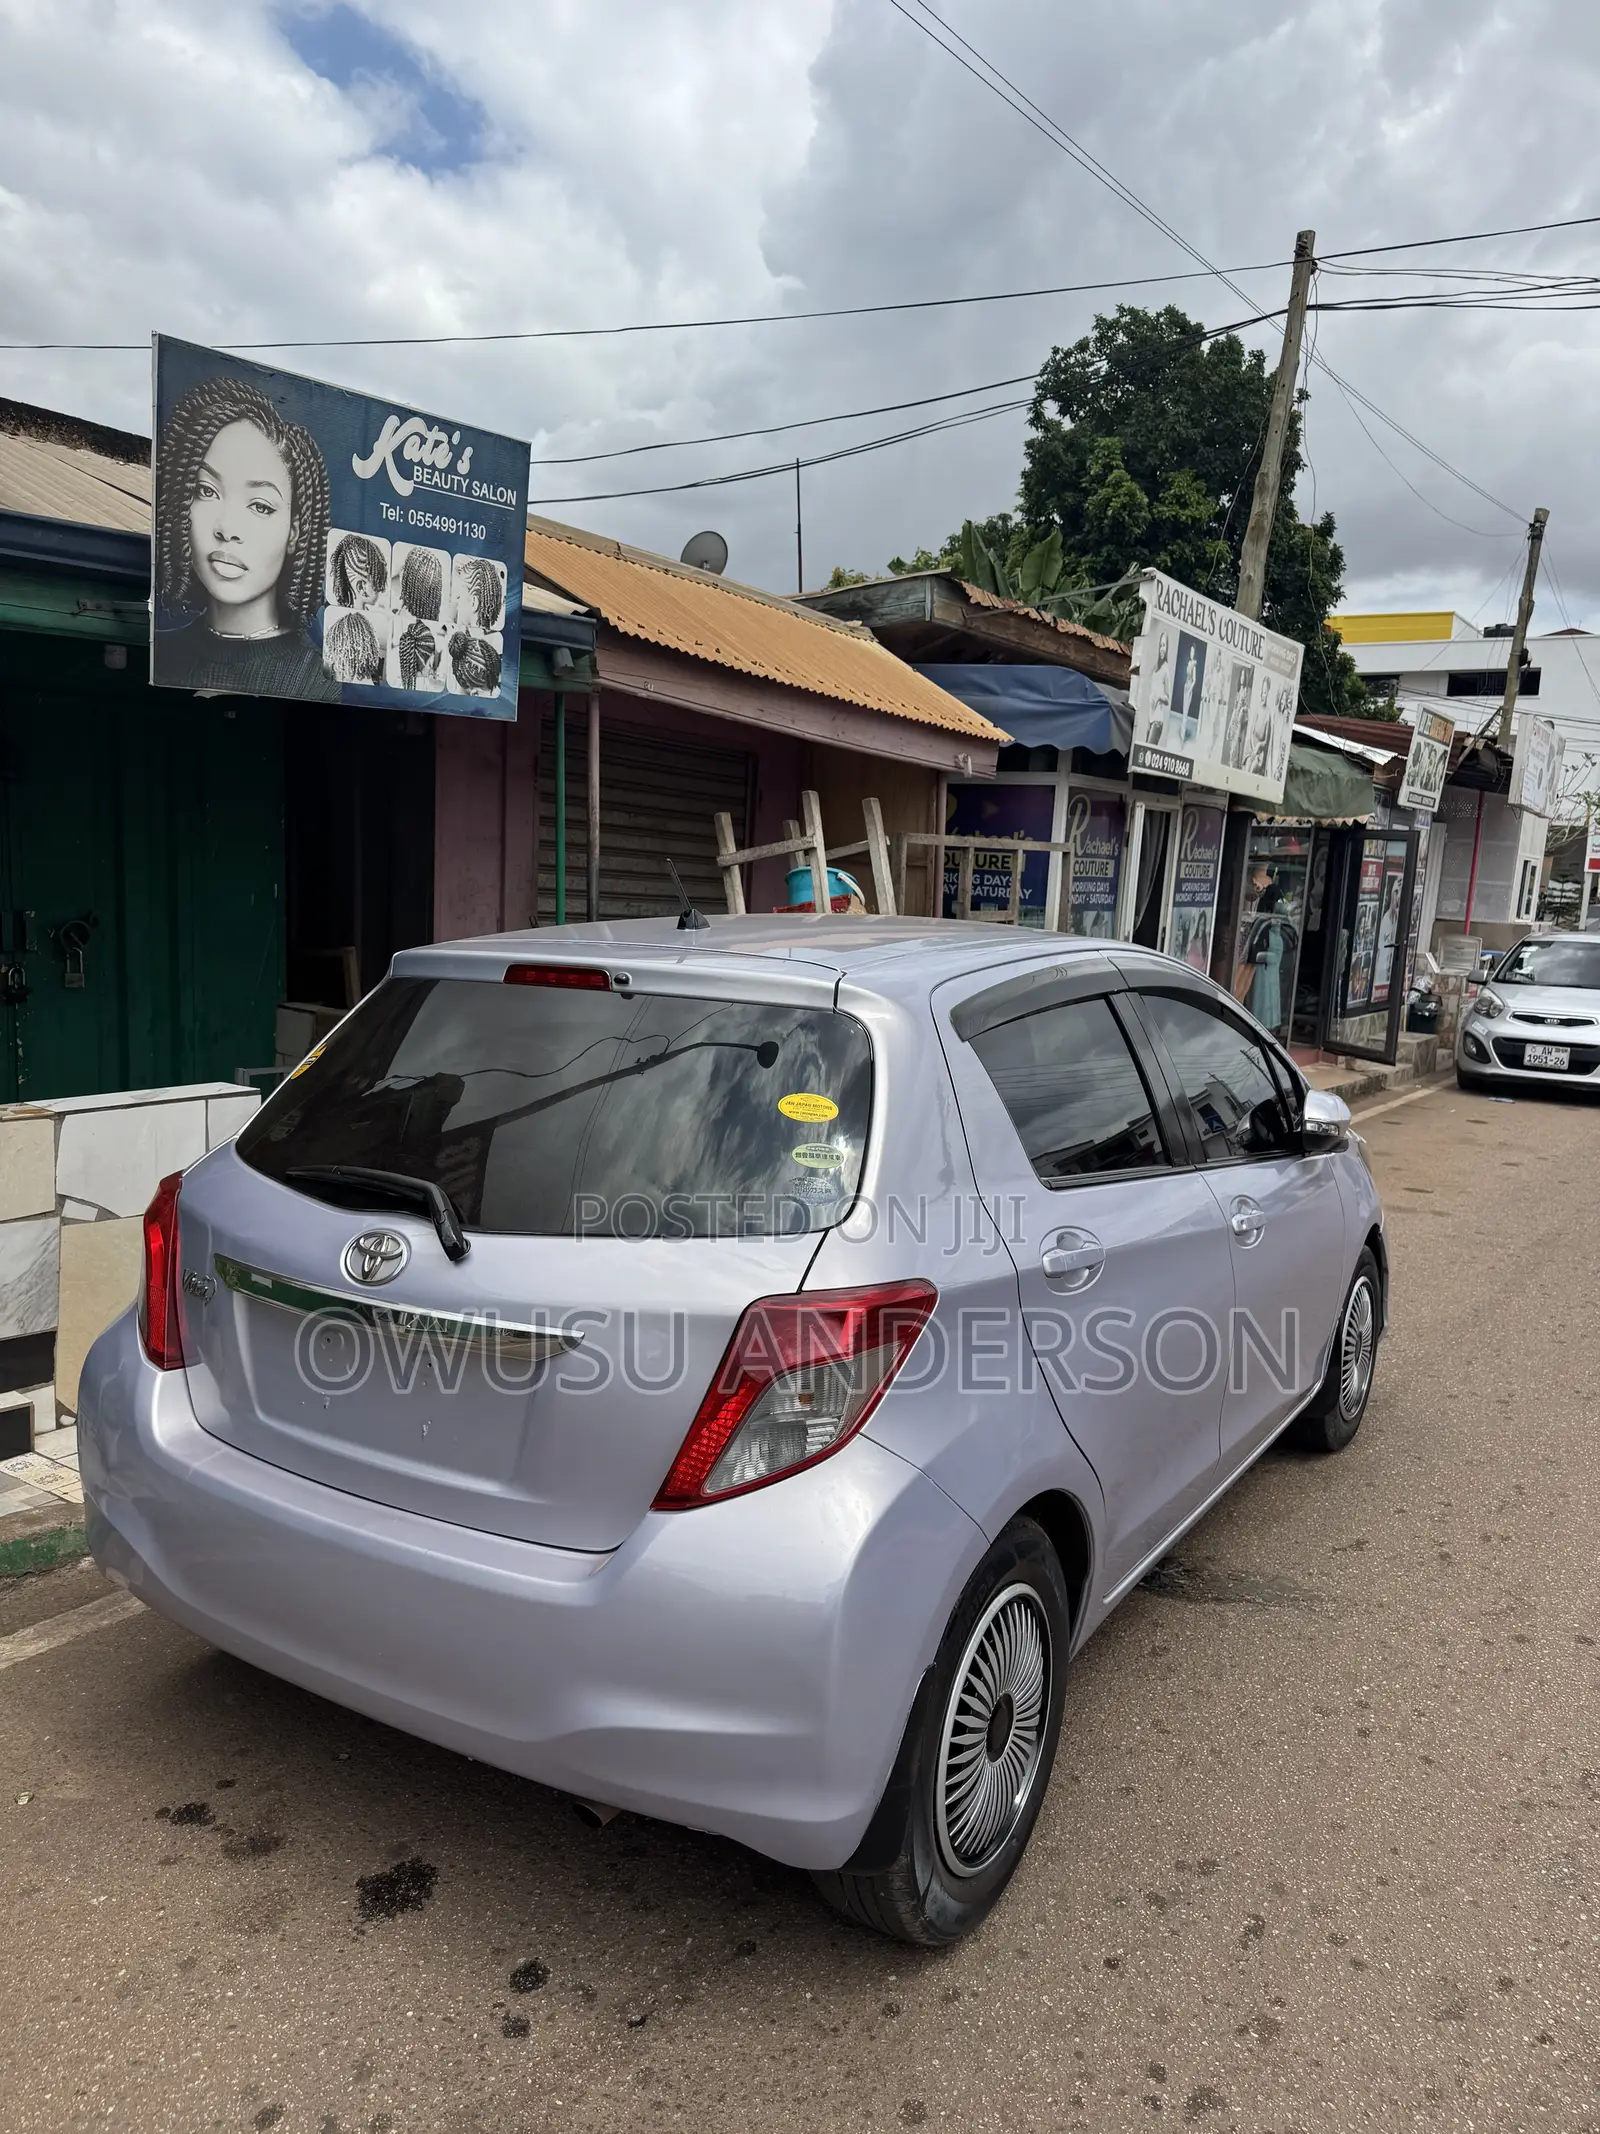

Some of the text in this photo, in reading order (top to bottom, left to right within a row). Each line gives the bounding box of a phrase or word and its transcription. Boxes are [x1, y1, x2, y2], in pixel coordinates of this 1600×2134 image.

[352, 414, 473, 497] Kate's
[413, 466, 517, 506] BEAUTY SALON
[380, 502, 487, 540] Tel: 0554991130
[1154, 579, 1266, 661] RACHAEL'S COUTURE
[1151, 753, 1190, 776] 024 910 8668
[1068, 794, 1119, 856] Rachael's
[1180, 808, 1218, 861] Rachael's
[1073, 860, 1109, 876] COUTURE
[1184, 863, 1210, 877] COUTURE
[1096, 881, 1110, 892] DAYS
[1089, 893, 1116, 905] SATURDAY
[1526, 1053, 1566, 1066] 1951-26
[1541, 1046, 1554, 1056] AW
